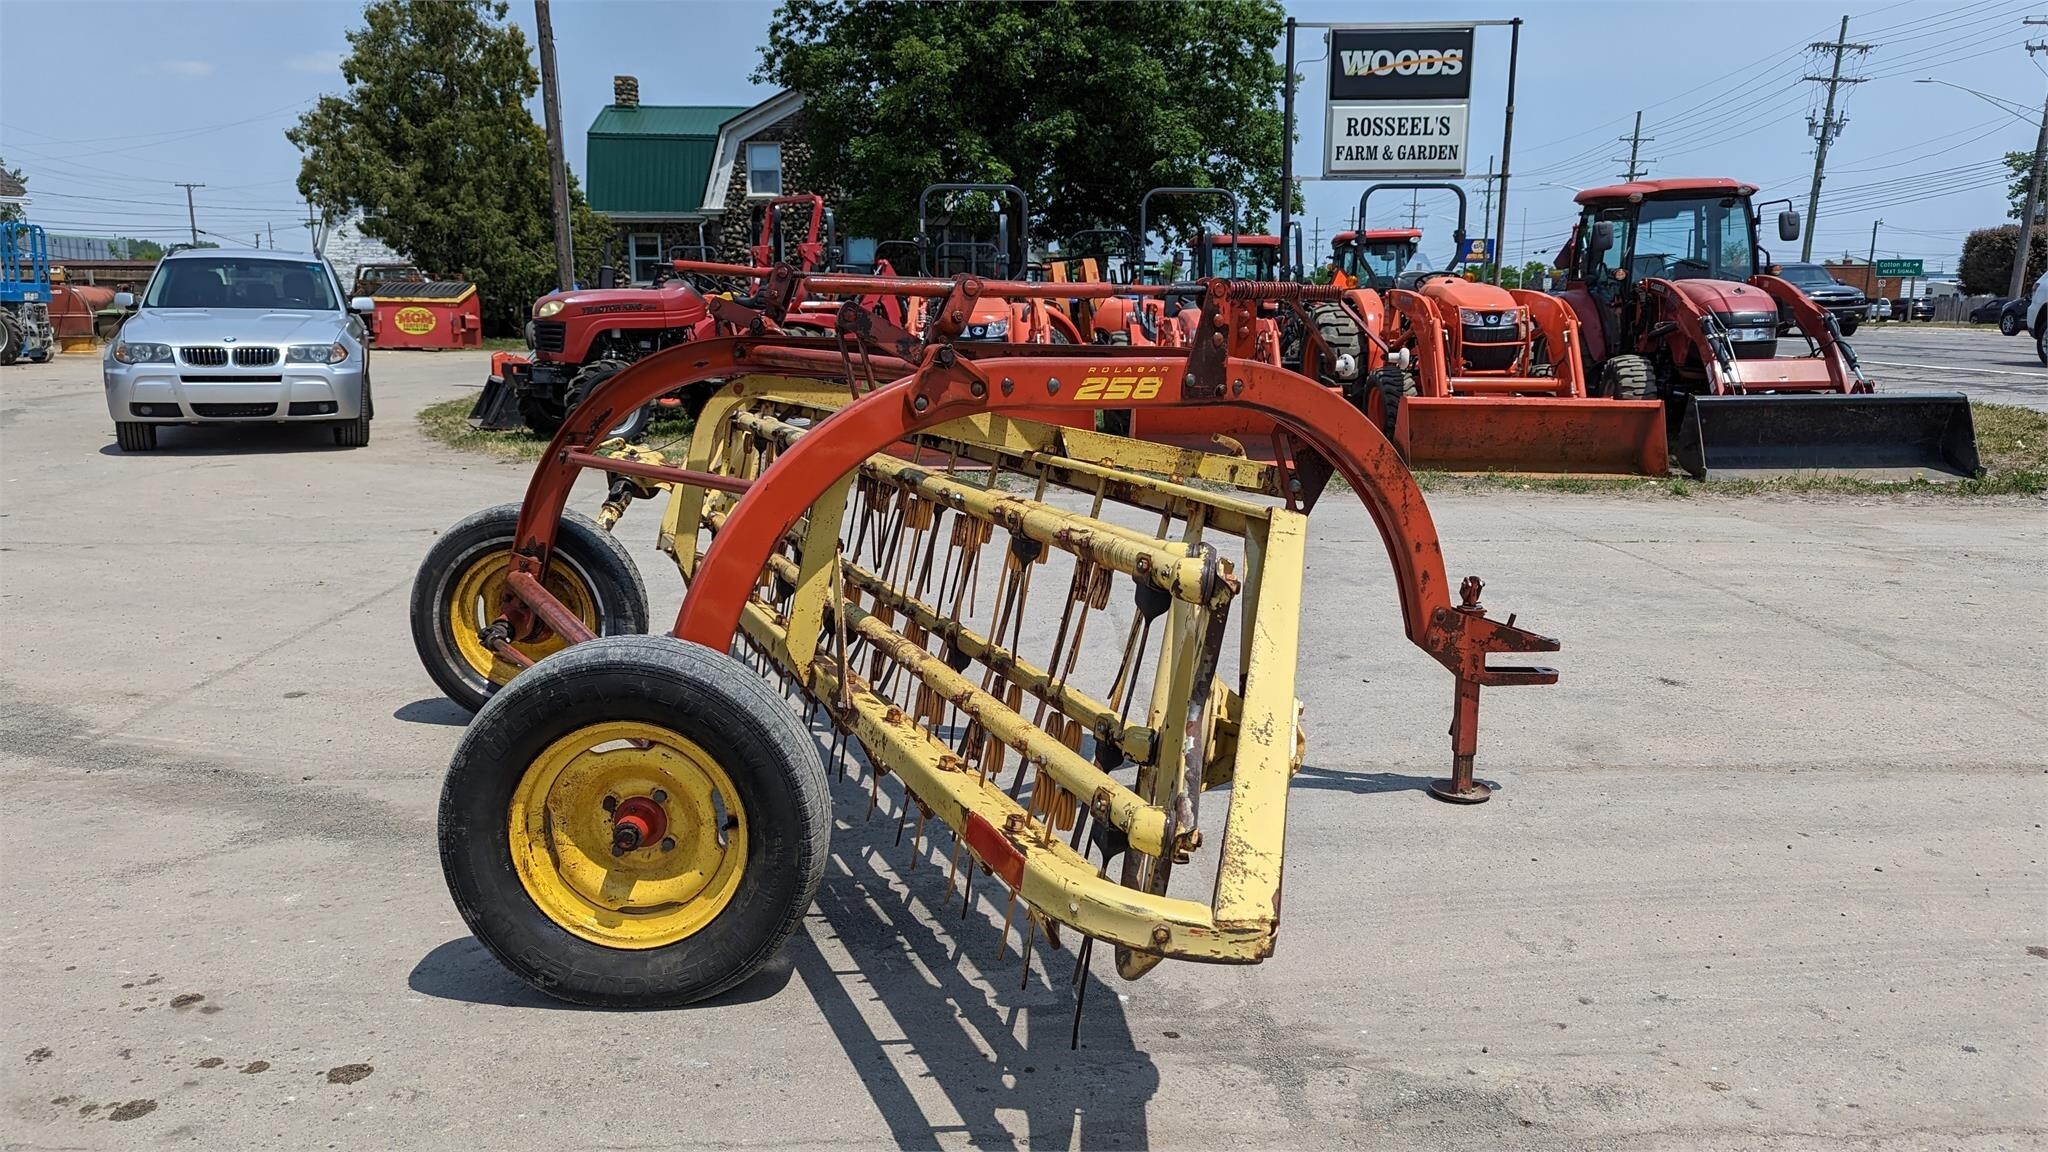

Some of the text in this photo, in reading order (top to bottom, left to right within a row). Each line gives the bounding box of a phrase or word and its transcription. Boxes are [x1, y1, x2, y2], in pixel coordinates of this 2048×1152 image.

[1340, 49, 1463, 76] WOODS
[1346, 116, 1450, 137] ROSSEEL'S
[1335, 145, 1459, 161] FARM & GARDEN
[398, 312, 433, 324] MGM
[1073, 377, 1163, 400] 258
